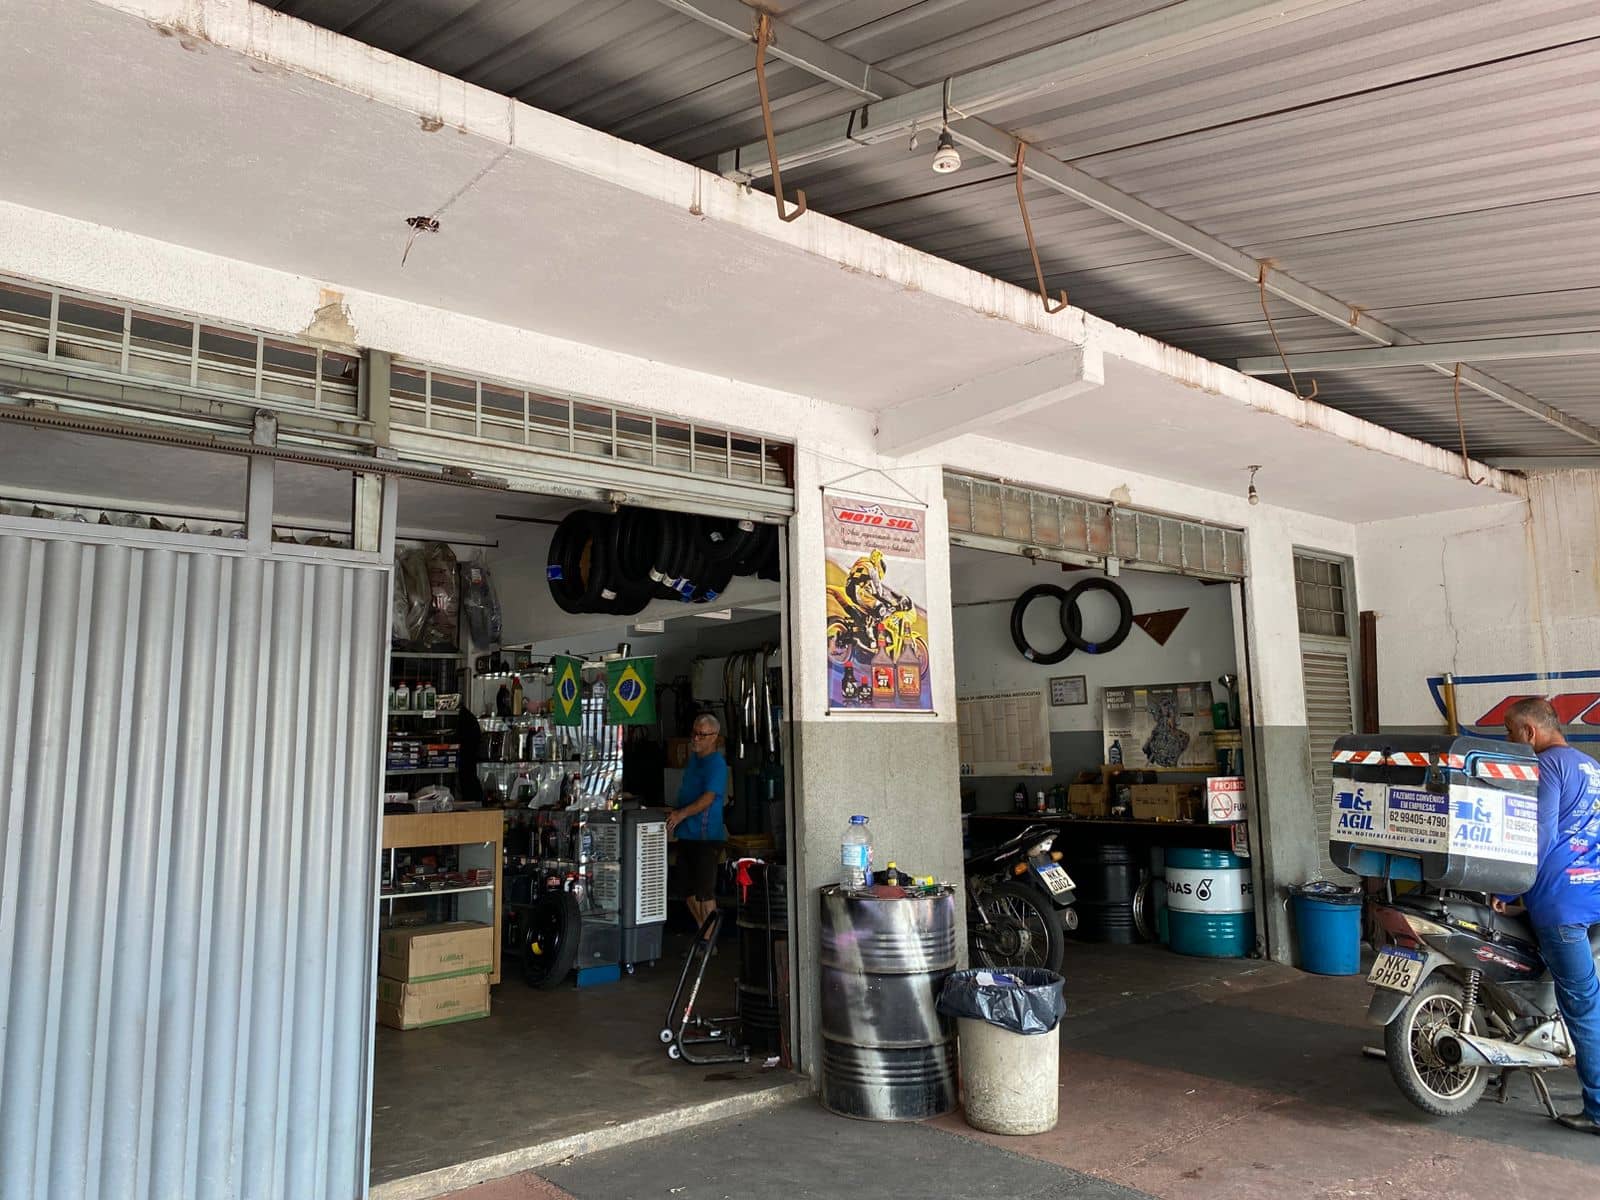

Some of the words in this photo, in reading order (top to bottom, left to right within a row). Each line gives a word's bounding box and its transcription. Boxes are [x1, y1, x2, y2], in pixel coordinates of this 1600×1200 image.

[839, 511, 883, 525] MOTO
[886, 518, 914, 530] SUL
[1214, 781, 1245, 791] PROIBID
[1392, 791, 1415, 800] FAZEMOS
[1233, 803, 1248, 812] FUM
[1400, 801, 1408, 809] EM
[1408, 802, 1436, 812] EMPRESAS
[1338, 813, 1375, 831] AGIL
[1389, 811, 1399, 822] 62
[1400, 812, 1447, 827] 99405-4790
[1454, 823, 1493, 843] AGIL
[1384, 955, 1410, 974] NKL
[1374, 968, 1411, 988] 9H98
